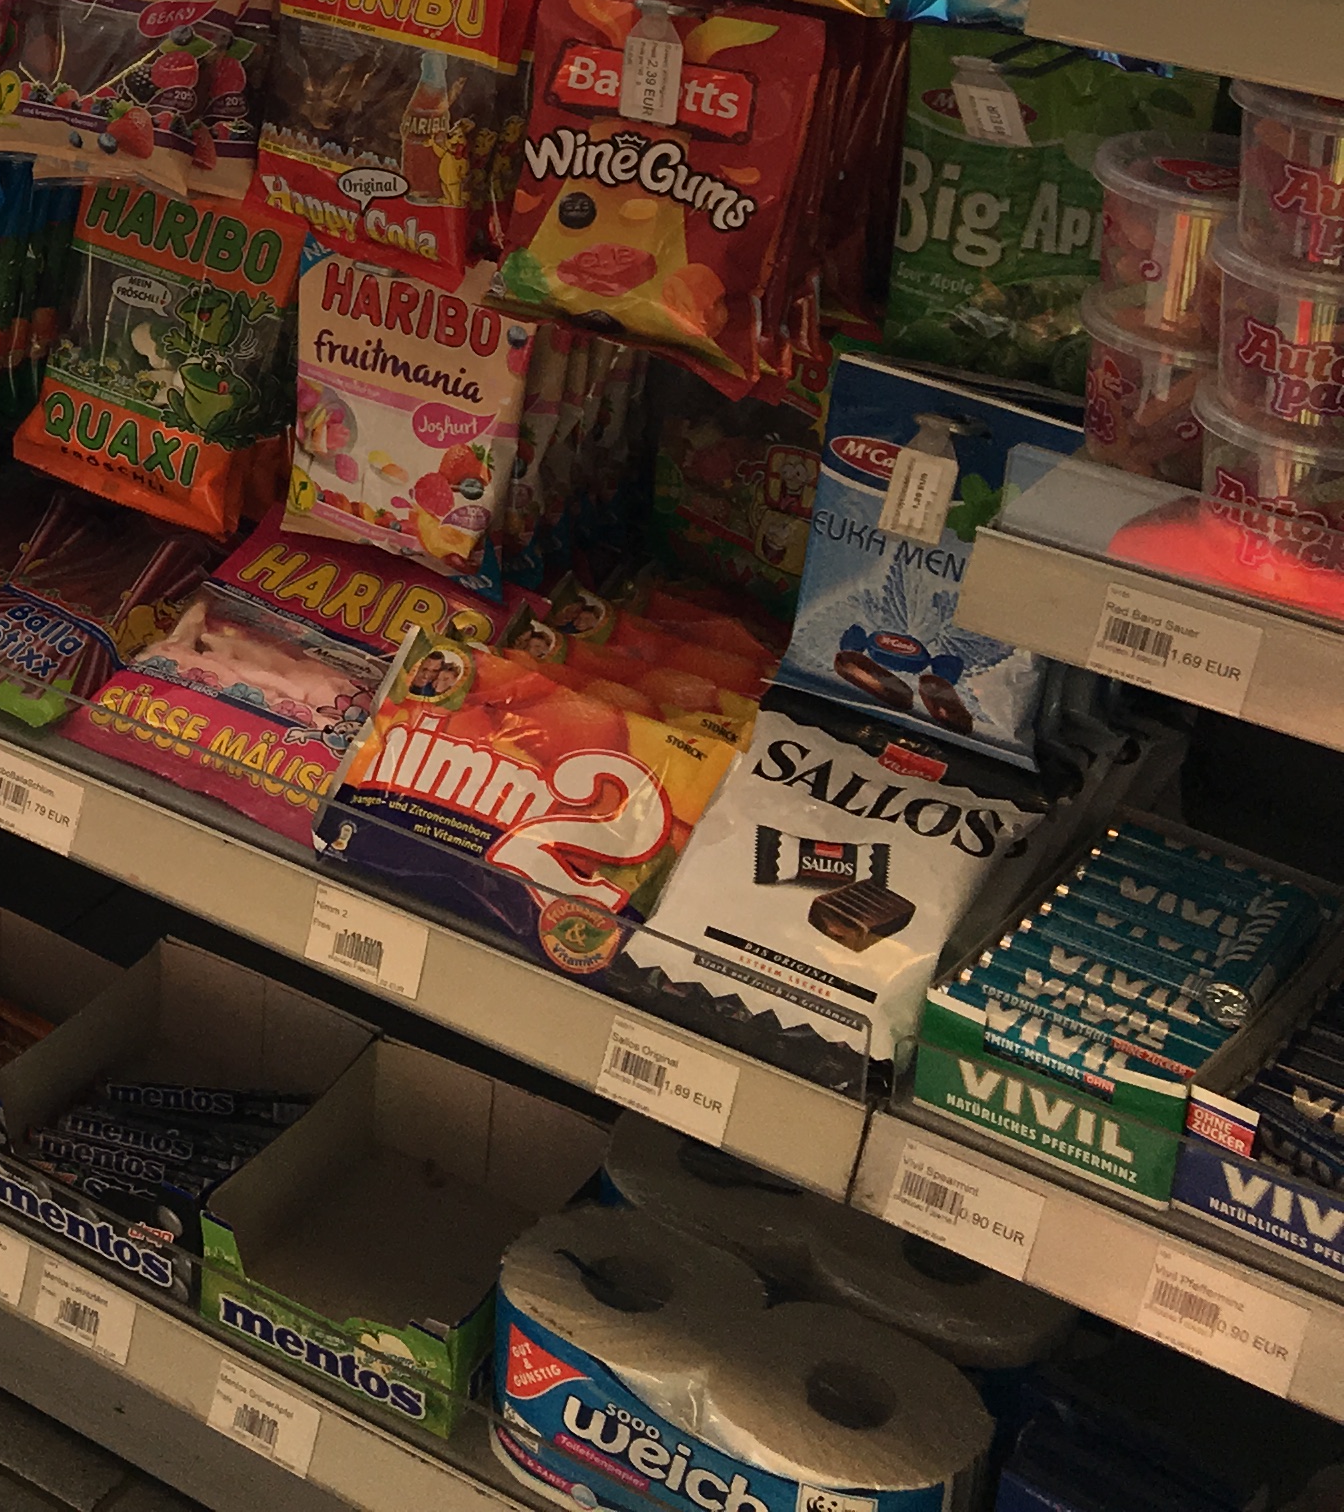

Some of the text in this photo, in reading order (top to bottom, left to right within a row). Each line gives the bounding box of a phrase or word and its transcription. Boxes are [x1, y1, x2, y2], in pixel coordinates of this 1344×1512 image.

[146, 6, 197, 26] BERRY
[343, 177, 399, 197] Original
[894, 148, 1011, 270] Big
[365, 210, 439, 263] Cola
[320, 262, 502, 358] HARIBO
[313, 329, 483, 404] fruitmania
[44, 390, 201, 489] QUAXI
[417, 414, 479, 440] Joghurt
[814, 509, 886, 556] EUKA
[7, 604, 84, 656] Balla
[1106, 601, 1200, 639] Red Band Sauer
[1205, 656, 1242, 682] EUR
[89, 684, 210, 757] SÜSSE
[700, 718, 738, 743] STORCK
[665, 734, 706, 761] STORCK
[364, 711, 556, 826] nimm
[753, 740, 1004, 858] SALLOS
[388, 799, 493, 841] und Zitronenbonbons
[413, 823, 485, 855] mit Vitaminen
[801, 855, 854, 877] SALLOS
[772, 952, 836, 986] ORIGINAL
[612, 1031, 679, 1070] Sallos Original
[692, 1090, 724, 1115] EUR
[957, 1058, 1135, 1165] VIVIL
[1193, 1106, 1235, 1136] OHNE
[945, 1091, 1138, 1185] NATÜRLICHES PFEFFERMINZ
[1192, 1117, 1246, 1155] ZUCKER
[992, 1221, 1025, 1247] EUR
[1208, 1197, 1308, 1252] NATÜRLICHES
[220, 1291, 427, 1420] mentos
[511, 1342, 533, 1358] GUT
[604, 1402, 661, 1441] sooo
[562, 1393, 770, 1512] weich
